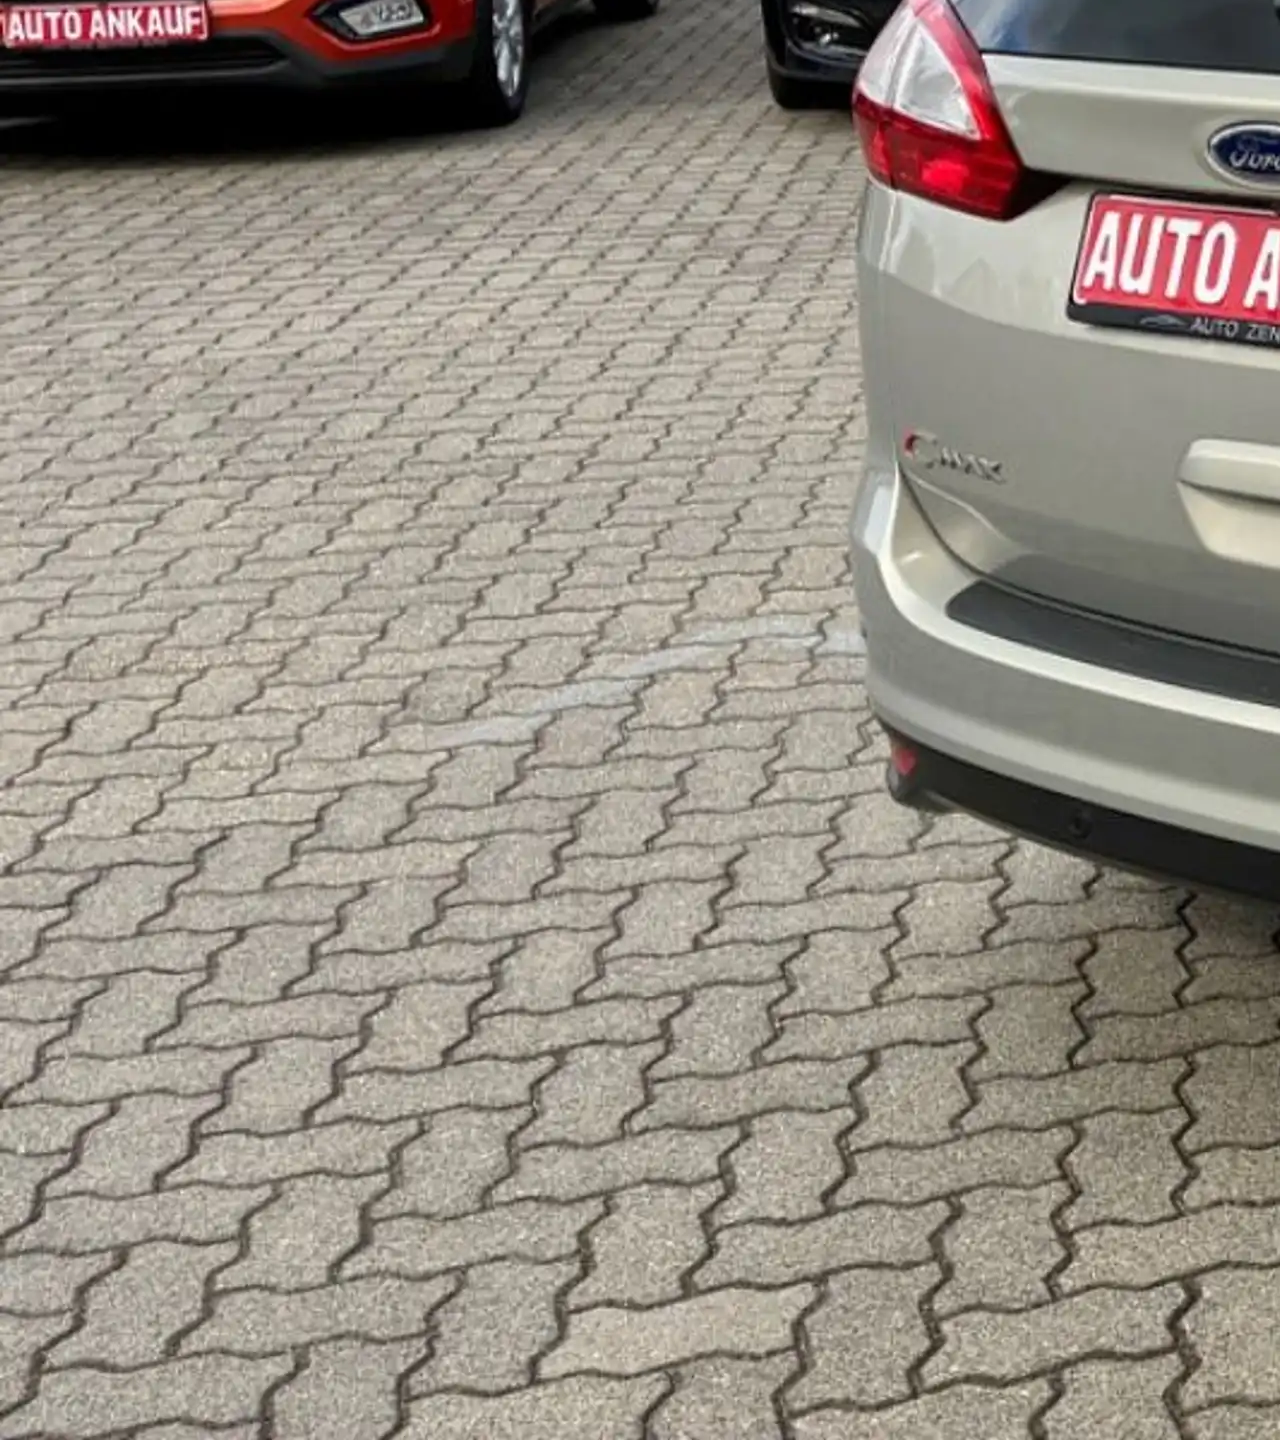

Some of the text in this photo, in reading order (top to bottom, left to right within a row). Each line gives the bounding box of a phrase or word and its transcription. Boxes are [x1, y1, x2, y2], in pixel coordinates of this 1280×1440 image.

[8, 4, 201, 41] AUTO ANKAUF
[1081, 210, 1239, 305] AUTO
[1189, 316, 1240, 338] AUTO
